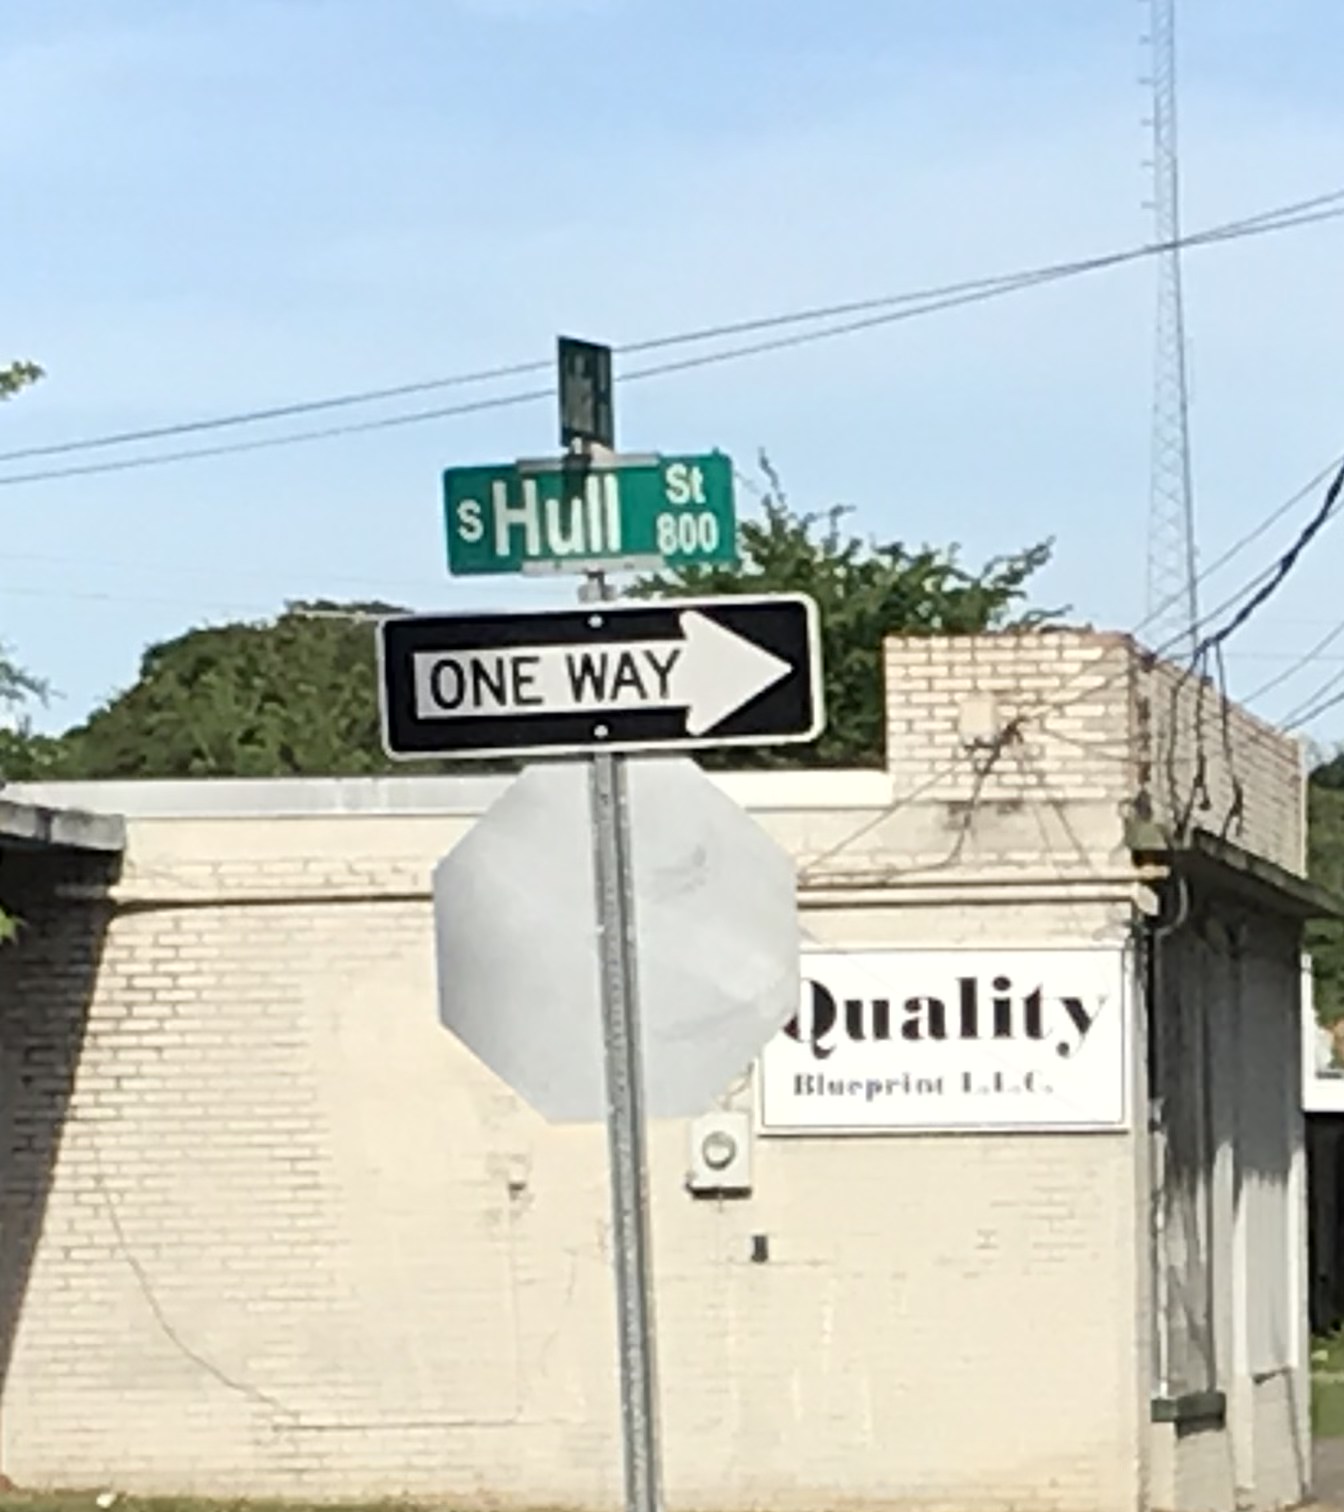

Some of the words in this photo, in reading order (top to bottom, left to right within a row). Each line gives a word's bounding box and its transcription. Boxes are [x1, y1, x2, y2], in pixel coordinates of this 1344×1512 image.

[665, 462, 706, 505] St
[456, 499, 483, 542] S
[492, 473, 622, 556] Hull
[655, 512, 720, 555] 800
[429, 656, 544, 711] ONE
[566, 648, 681, 703] WAY
[781, 975, 1110, 1060] Quality
[793, 1073, 945, 1103] Blueprint
